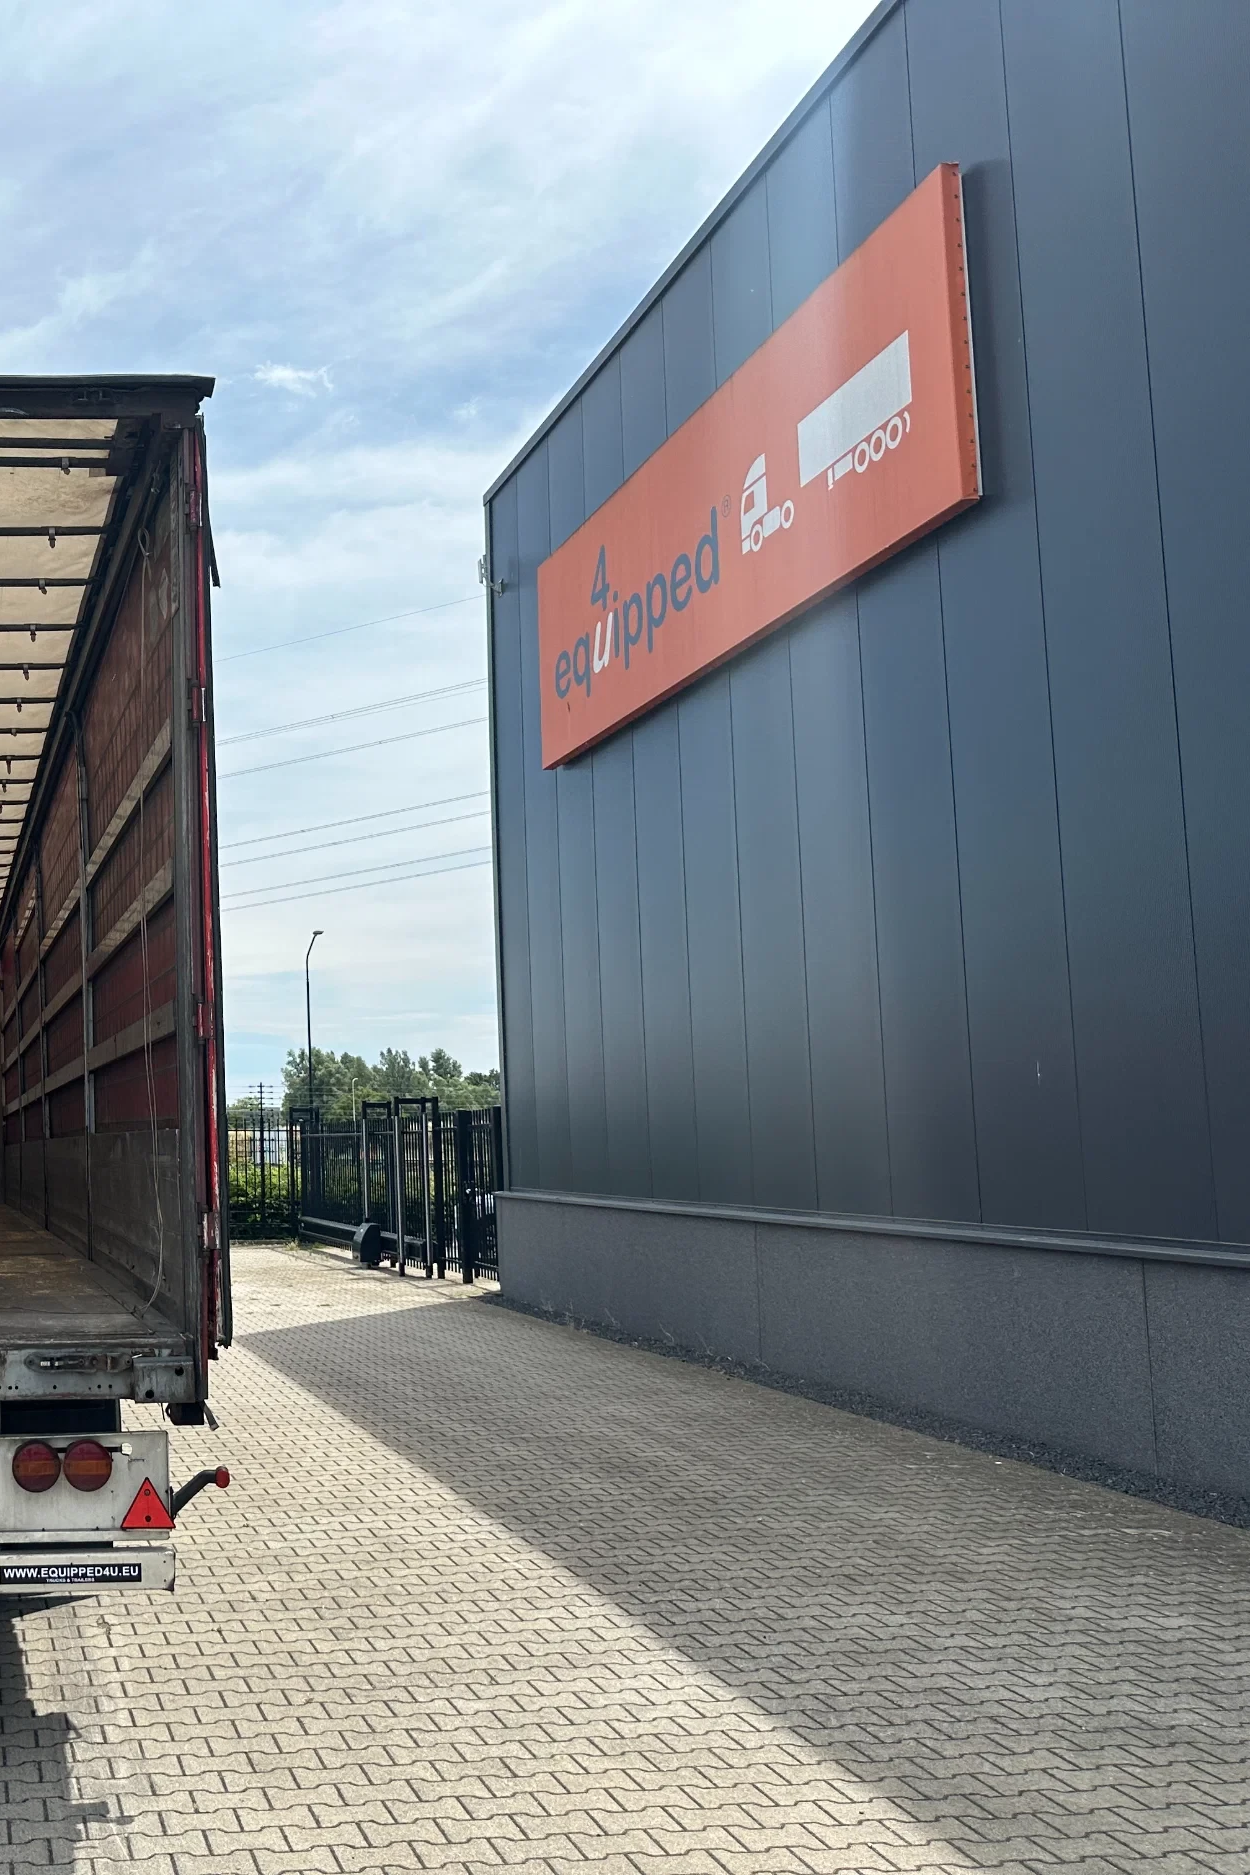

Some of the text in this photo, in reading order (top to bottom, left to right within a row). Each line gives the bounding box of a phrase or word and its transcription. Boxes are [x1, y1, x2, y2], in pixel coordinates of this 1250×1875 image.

[555, 506, 720, 699] equipped
[591, 544, 610, 611] 4
[3, 1566, 139, 1578] WWW.EQUIPPED4U.EU
